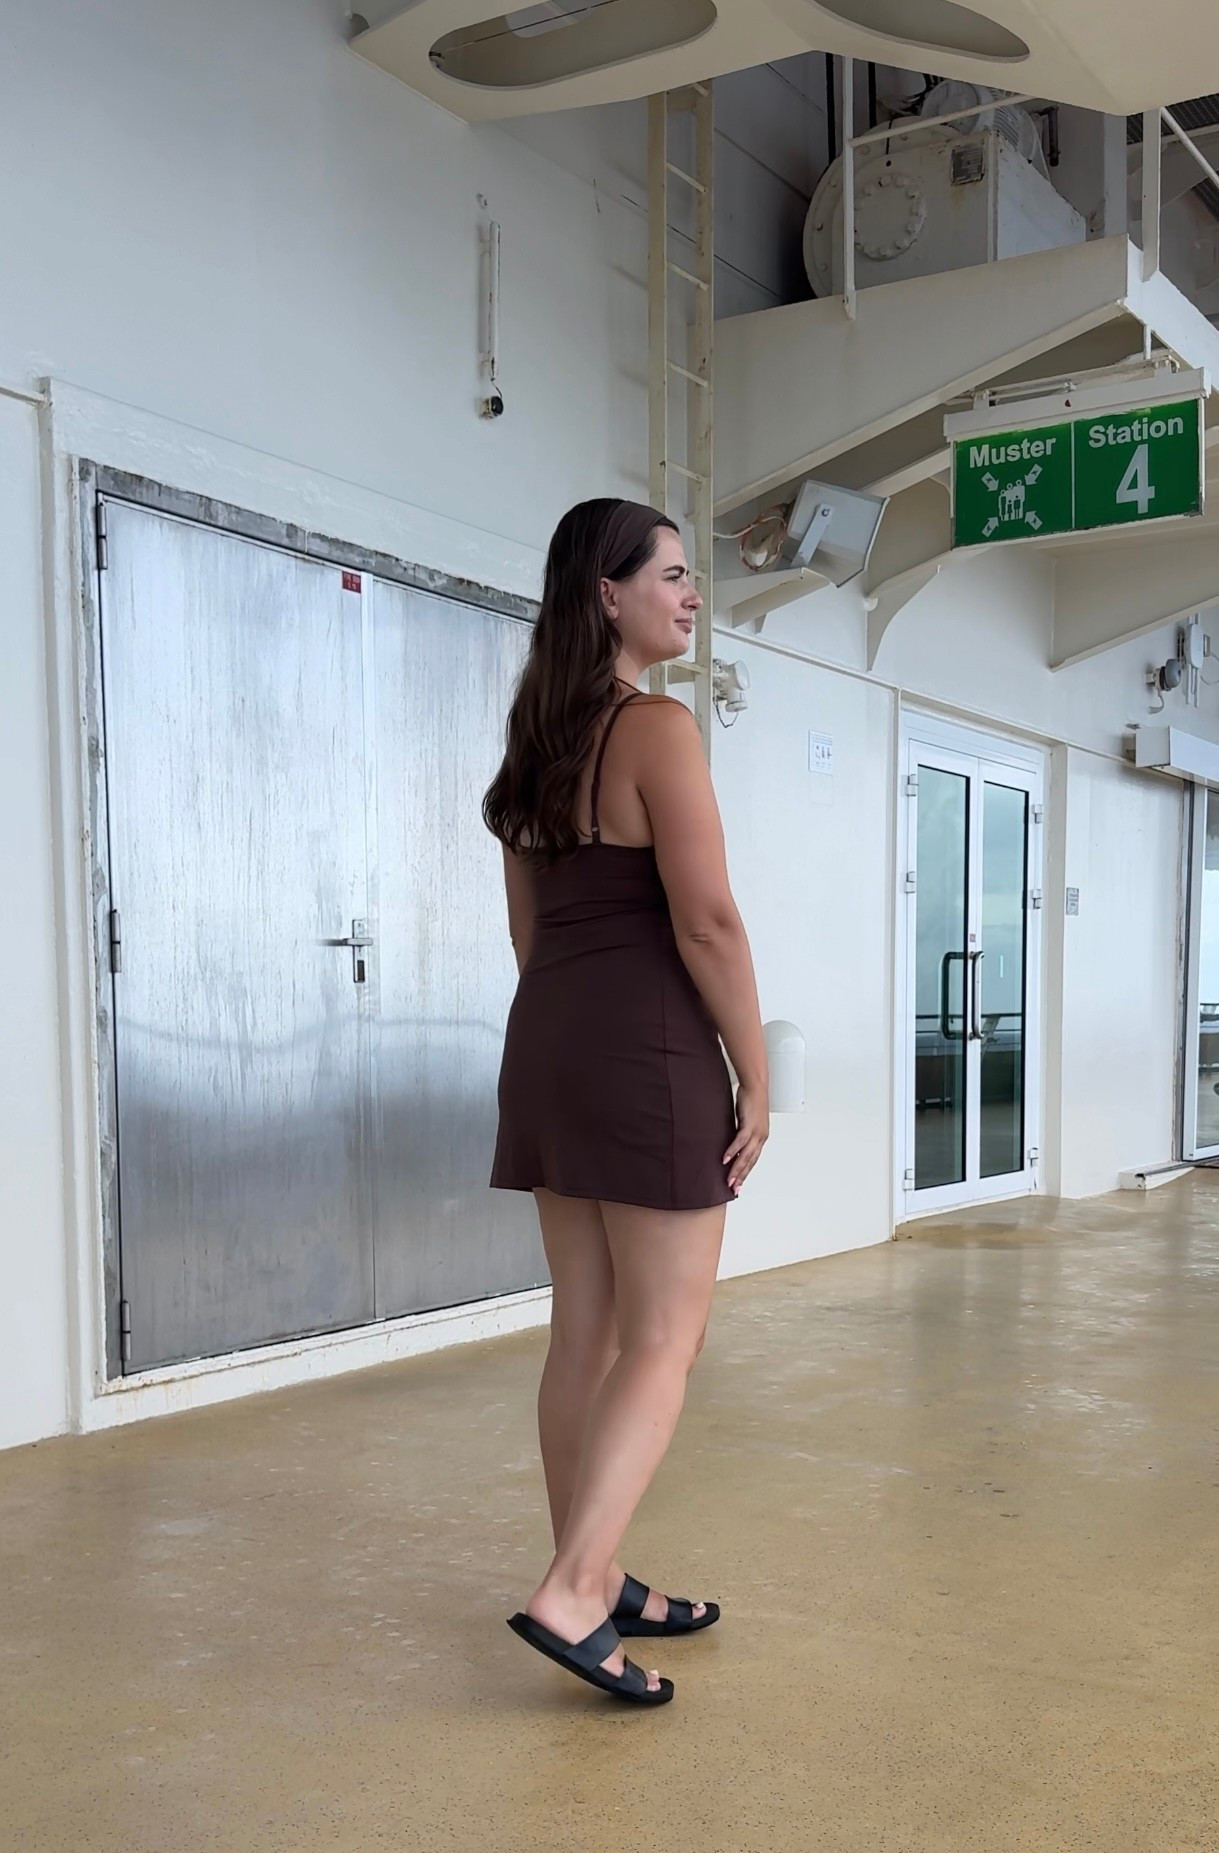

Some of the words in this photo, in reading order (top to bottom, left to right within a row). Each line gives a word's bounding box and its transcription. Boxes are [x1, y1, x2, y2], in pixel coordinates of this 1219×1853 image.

[969, 437, 1056, 468] Muster
[1088, 417, 1184, 448] Station
[1116, 443, 1155, 514] 4
